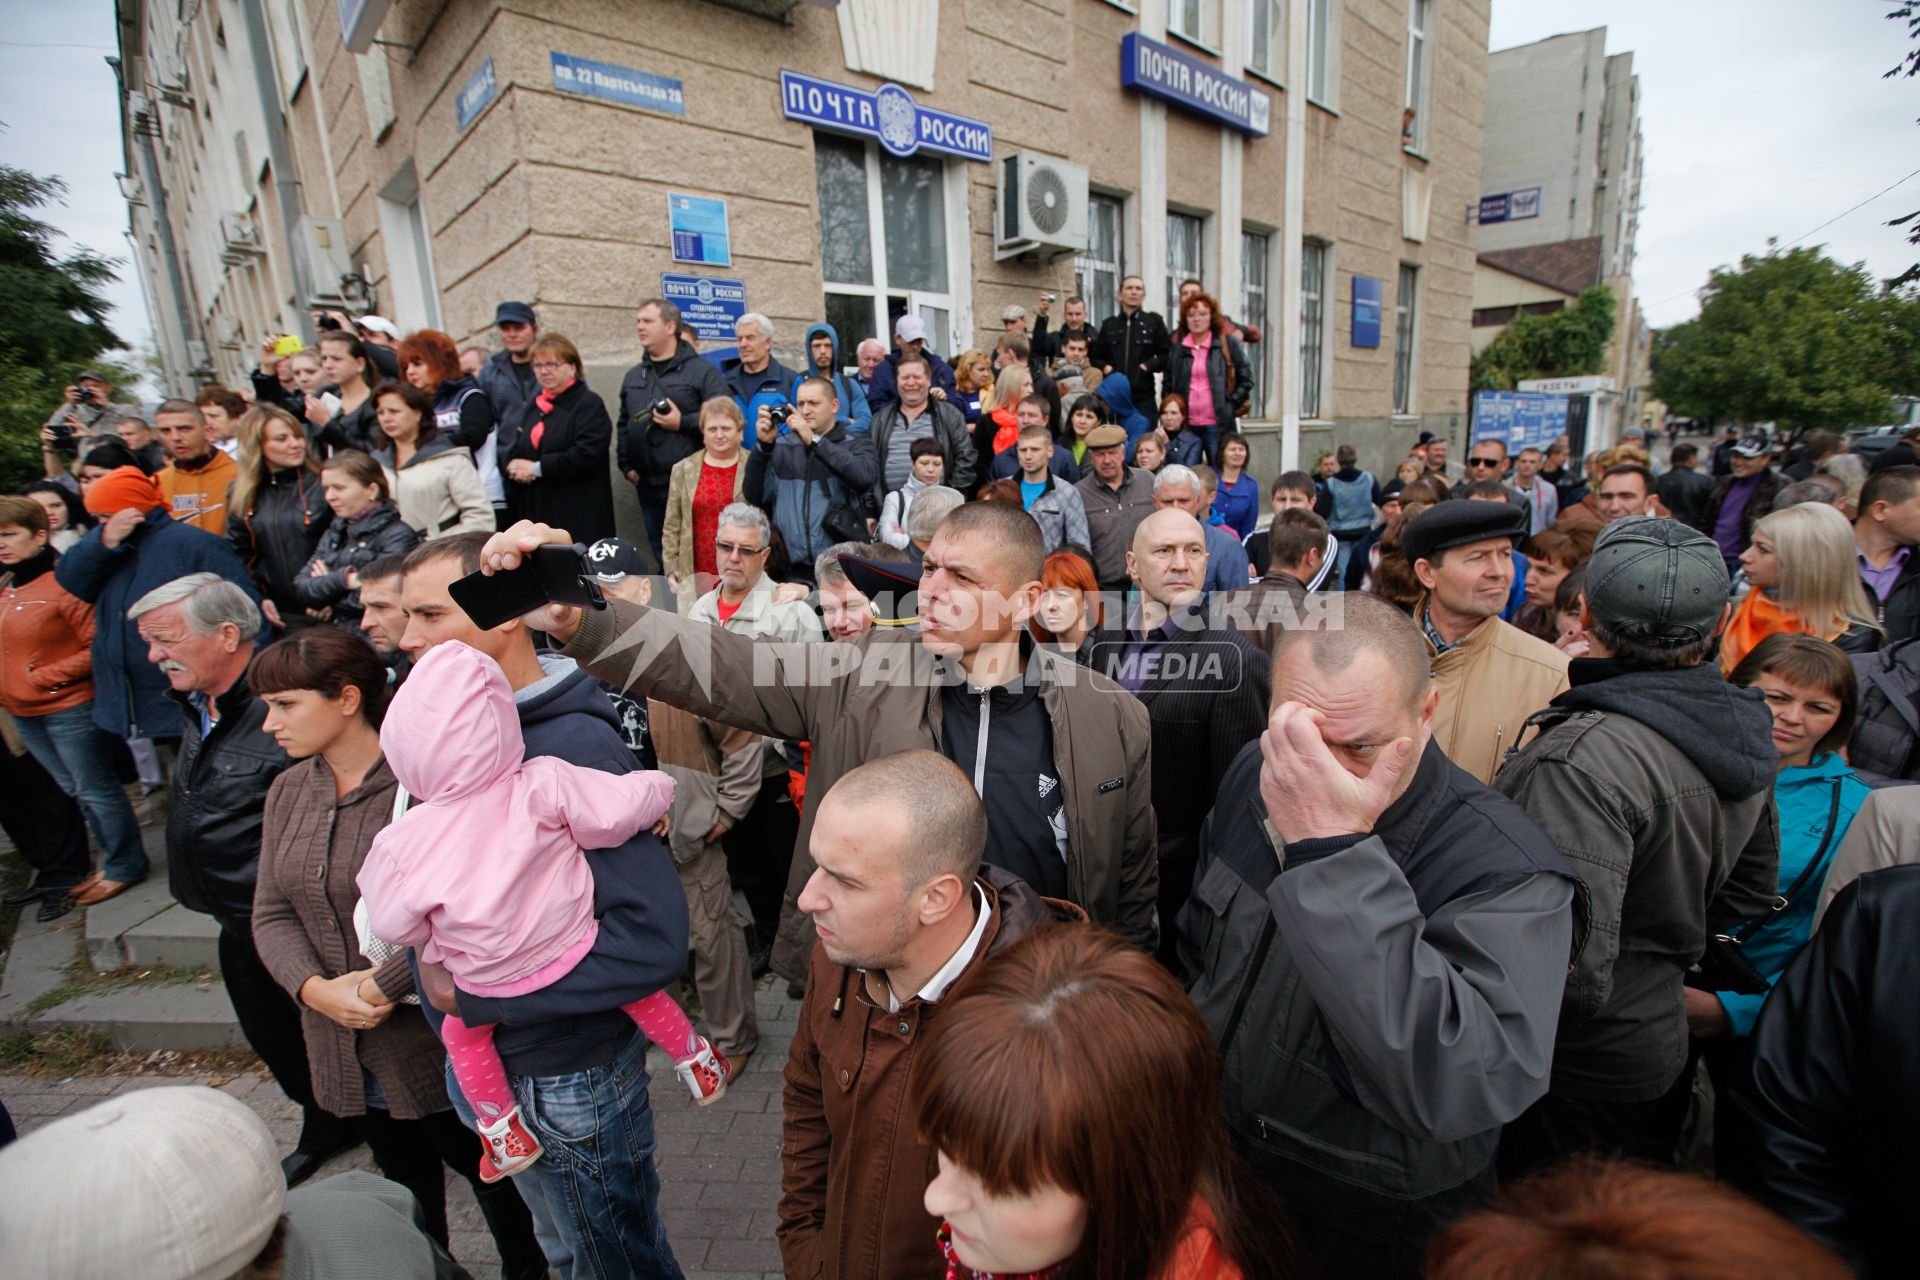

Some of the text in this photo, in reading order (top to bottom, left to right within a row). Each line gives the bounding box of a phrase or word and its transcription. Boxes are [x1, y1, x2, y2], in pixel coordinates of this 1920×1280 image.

[576, 67, 592, 84] 22
[1140, 45, 1248, 118] ПОЧТА РОССИИ
[788, 82, 989, 153] ПОЧТА РОССИИ
[667, 285, 742, 298] ПОЧТА РОССИИ
